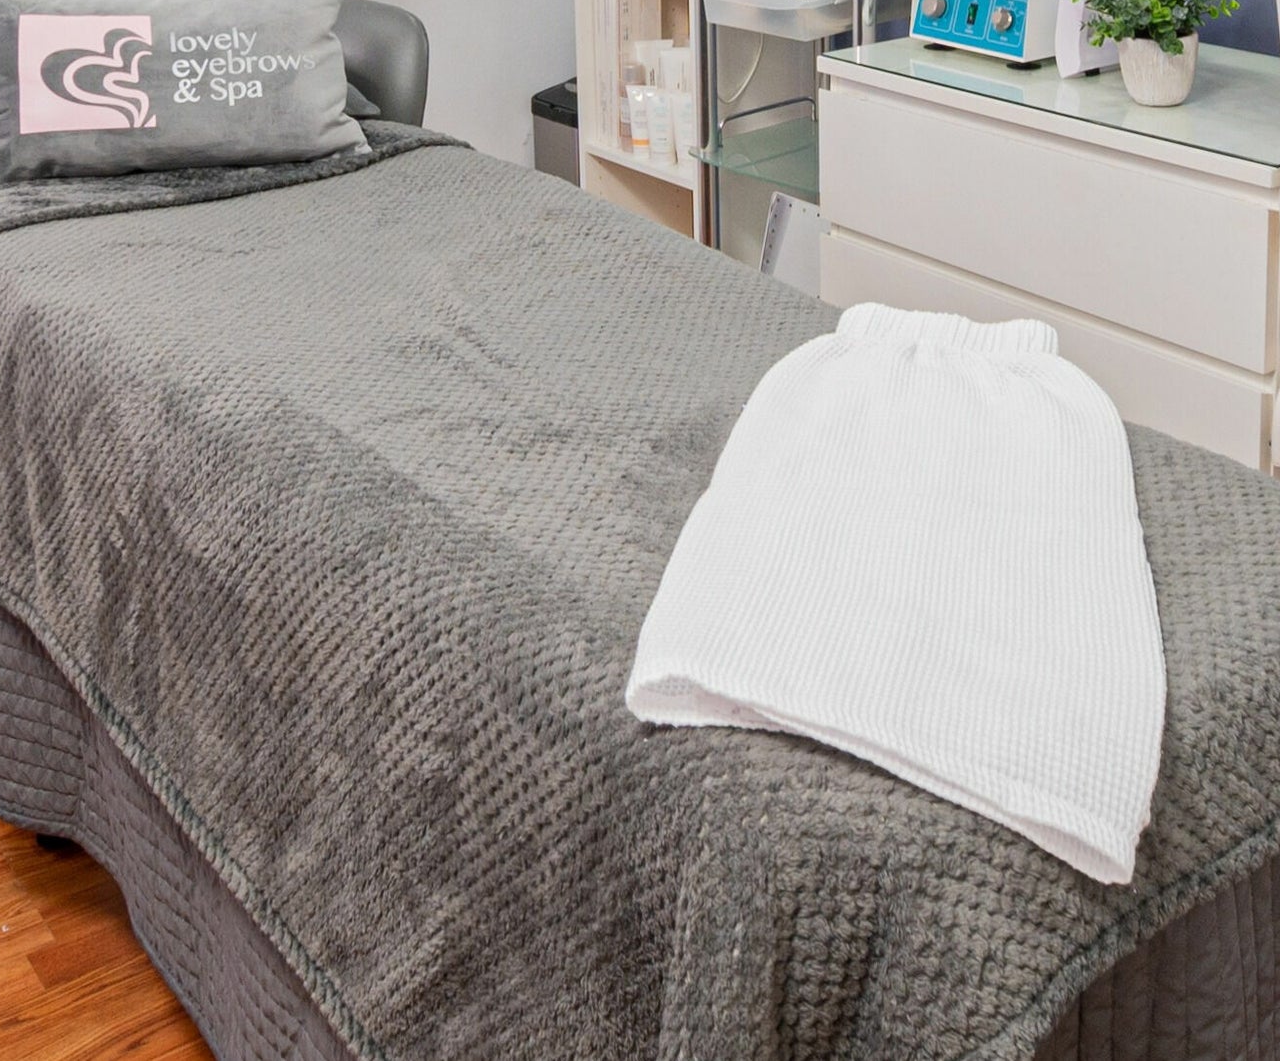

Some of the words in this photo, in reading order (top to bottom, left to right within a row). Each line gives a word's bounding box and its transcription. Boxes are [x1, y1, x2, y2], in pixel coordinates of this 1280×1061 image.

[170, 27, 257, 56] lovely
[172, 49, 316, 84] eyebrows
[173, 78, 201, 103] &
[210, 77, 263, 106] Spa
